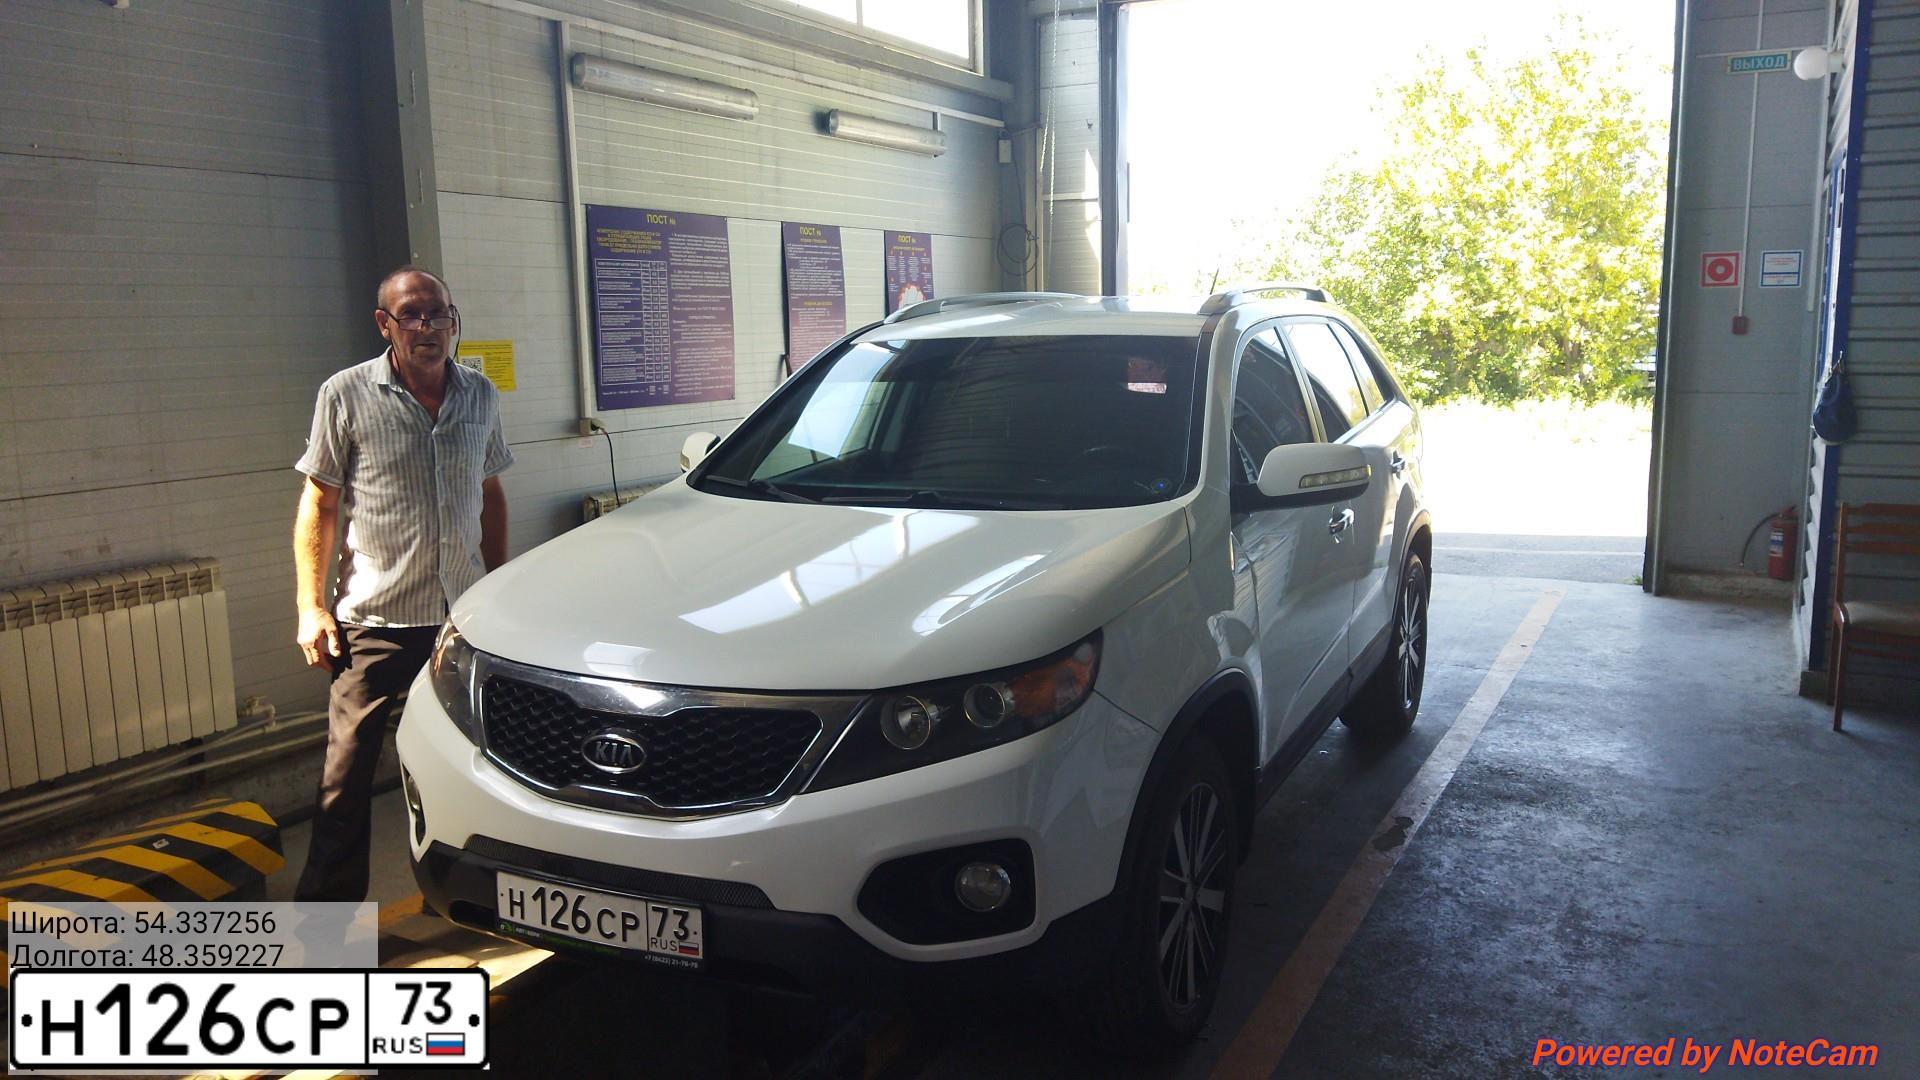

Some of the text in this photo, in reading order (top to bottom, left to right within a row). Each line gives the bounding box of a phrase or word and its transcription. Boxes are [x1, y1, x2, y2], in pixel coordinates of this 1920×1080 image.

[1733, 55, 1785, 70] ВЫХОД
[646, 213, 668, 225] ПОСТ
[595, 741, 634, 766] KIA
[651, 905, 690, 941] 73
[650, 937, 678, 952] RUS
